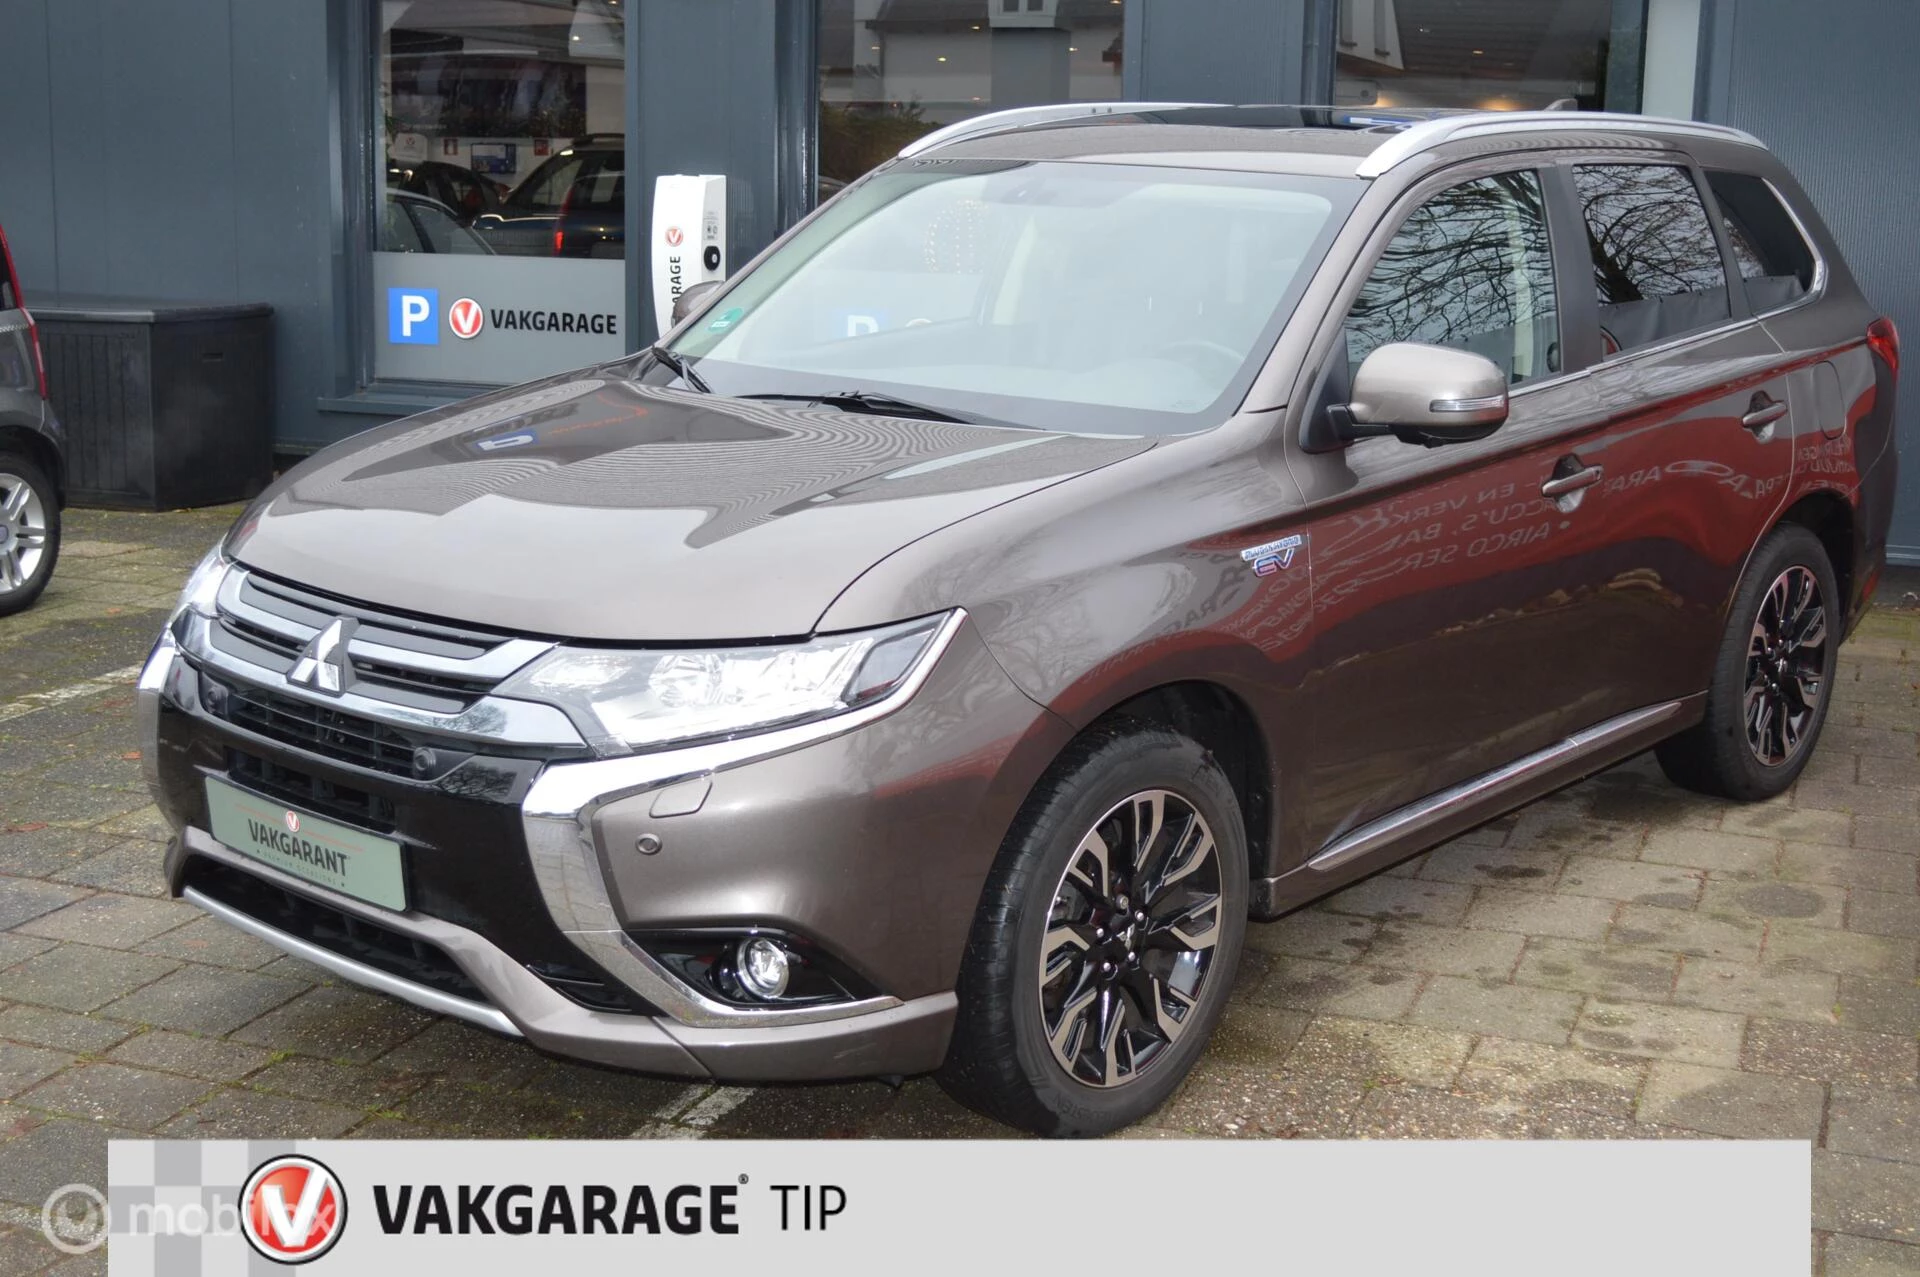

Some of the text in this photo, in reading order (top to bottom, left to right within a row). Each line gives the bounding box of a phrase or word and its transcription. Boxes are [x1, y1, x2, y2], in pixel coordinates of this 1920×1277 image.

[401, 295, 430, 337] P
[490, 309, 617, 335] VAKGARAGE
[247, 818, 348, 877] VAKGARANT
